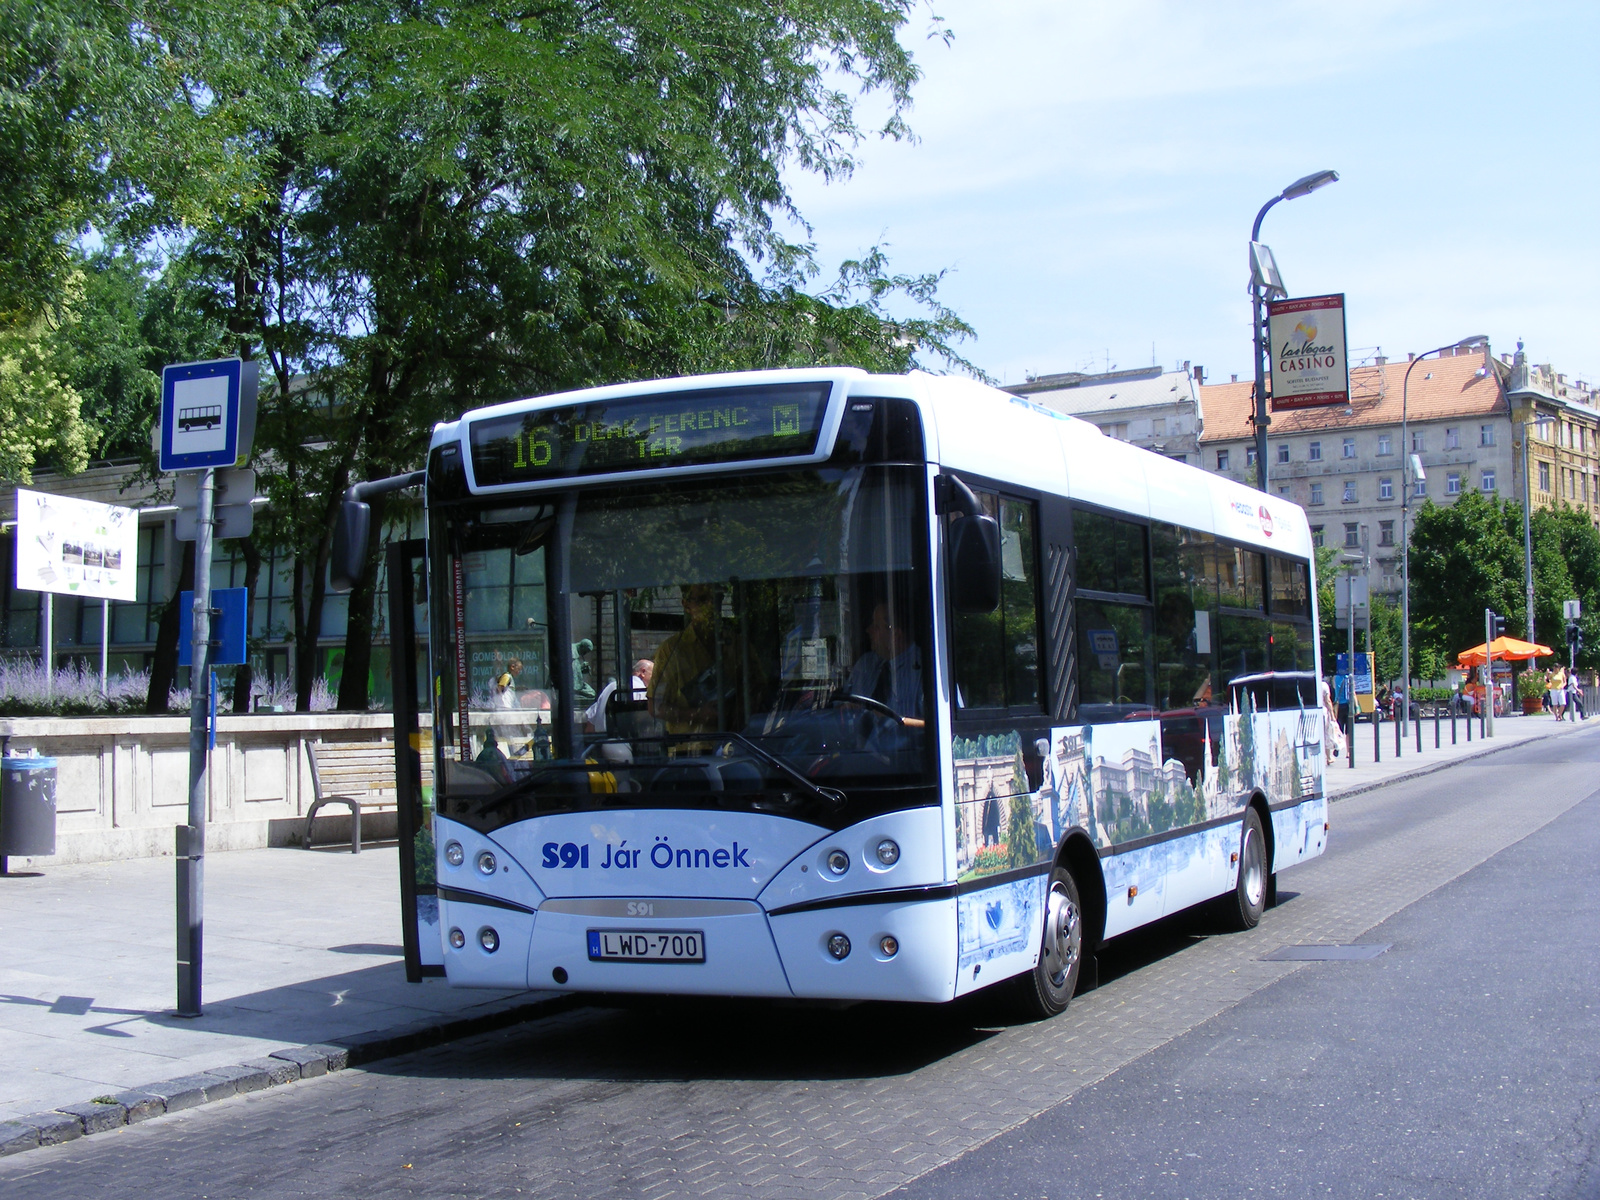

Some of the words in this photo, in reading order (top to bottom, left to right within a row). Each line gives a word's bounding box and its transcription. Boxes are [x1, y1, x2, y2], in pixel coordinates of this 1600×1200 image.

[1281, 342, 1300, 357] Las
[1301, 341, 1334, 357] Vegas
[1280, 356, 1335, 372] CASINO
[650, 407, 748, 434] FERENC
[513, 427, 551, 468] 16
[455, 560, 463, 605] HANDRAILS!
[472, 651, 514, 662] GOMBOLD
[472, 667, 494, 676] DIVAT
[461, 700, 469, 744] HANDRAILS!
[542, 842, 589, 869] S91
[600, 840, 641, 869] Jár
[650, 836, 750, 869] Önnek
[627, 902, 654, 916] S91
[592, 946, 599, 954] H
[604, 934, 698, 956] LWD-700
